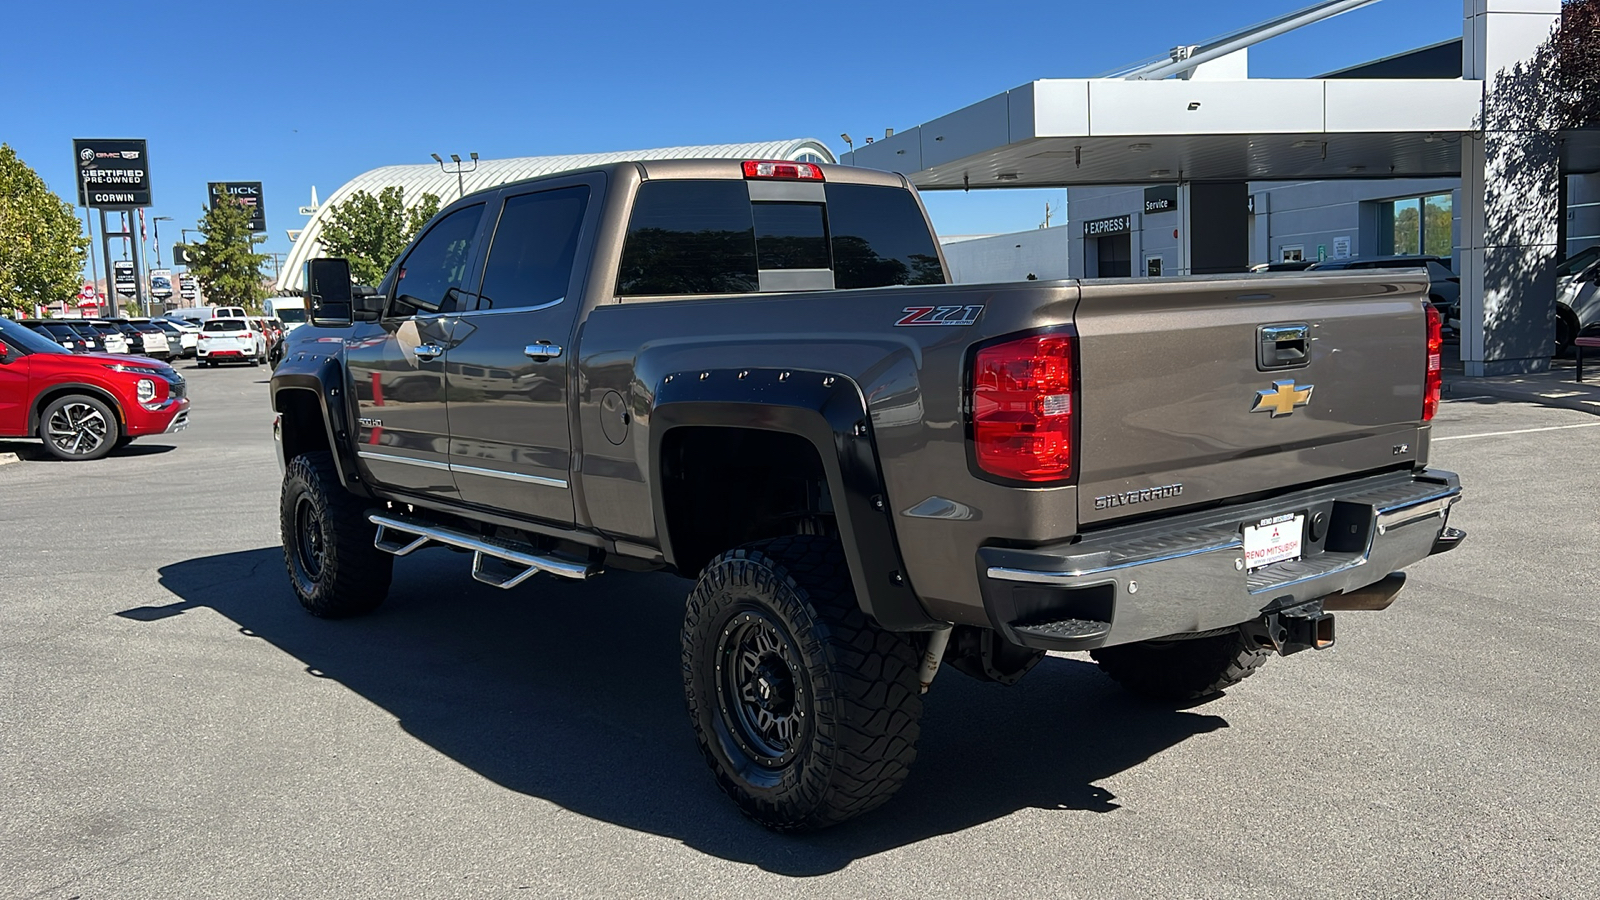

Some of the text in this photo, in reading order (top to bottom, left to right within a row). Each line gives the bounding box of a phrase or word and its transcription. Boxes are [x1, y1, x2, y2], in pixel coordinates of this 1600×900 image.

[81, 169, 144, 177] CERTIFIED
[84, 176, 141, 184] PRE-OWNED
[95, 193, 135, 202] CORWIN
[1145, 199, 1169, 211] Service
[1090, 218, 1124, 234] EXPRESS
[893, 304, 985, 326] Z71
[1094, 483, 1184, 511] SILVERADO
[1245, 540, 1298, 560] RENO MITSUBISHI
